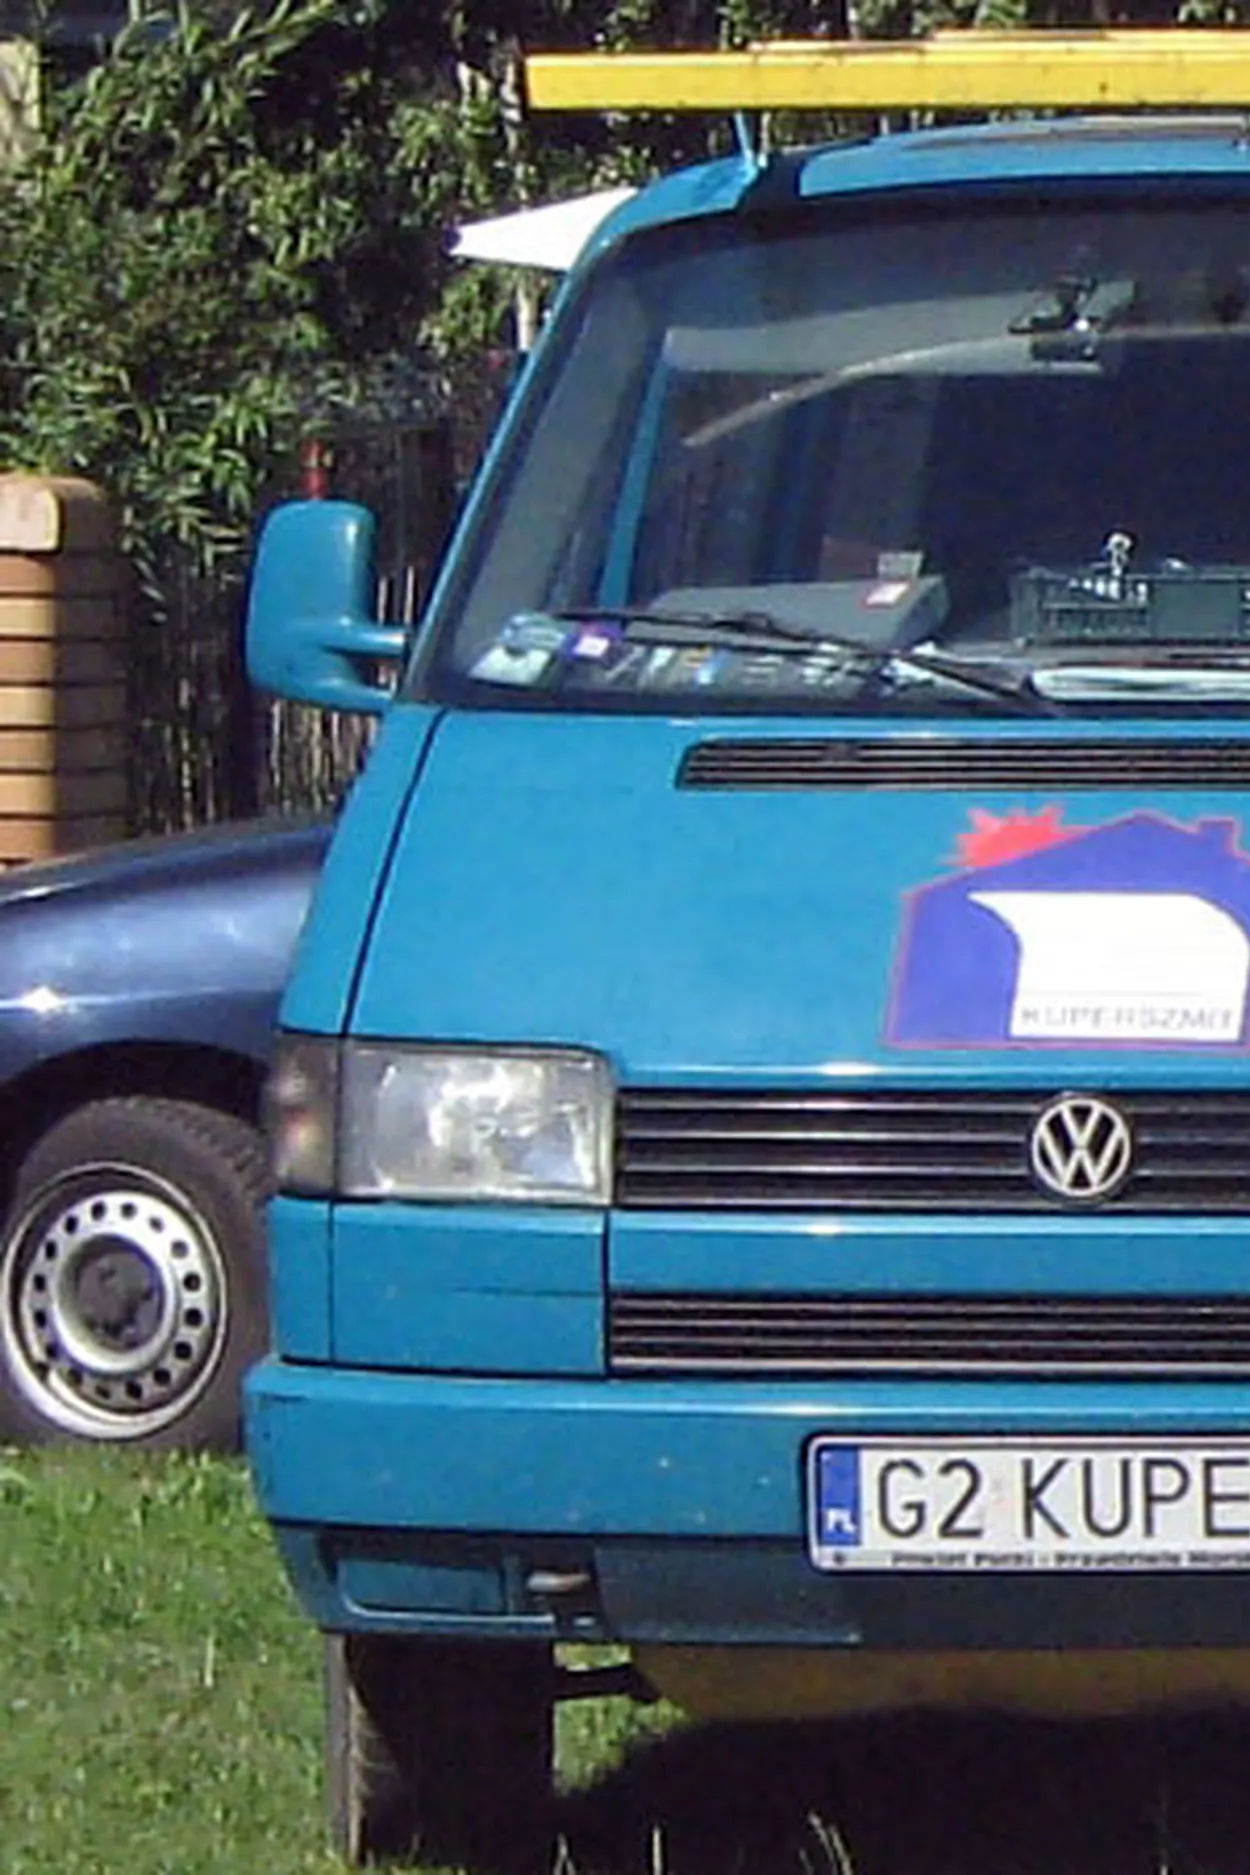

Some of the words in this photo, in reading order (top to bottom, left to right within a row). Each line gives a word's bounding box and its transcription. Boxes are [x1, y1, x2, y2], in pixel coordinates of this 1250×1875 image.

[1034, 1101, 1130, 1195] VW
[826, 1508, 855, 1532] PL
[877, 1458, 985, 1540] G2
